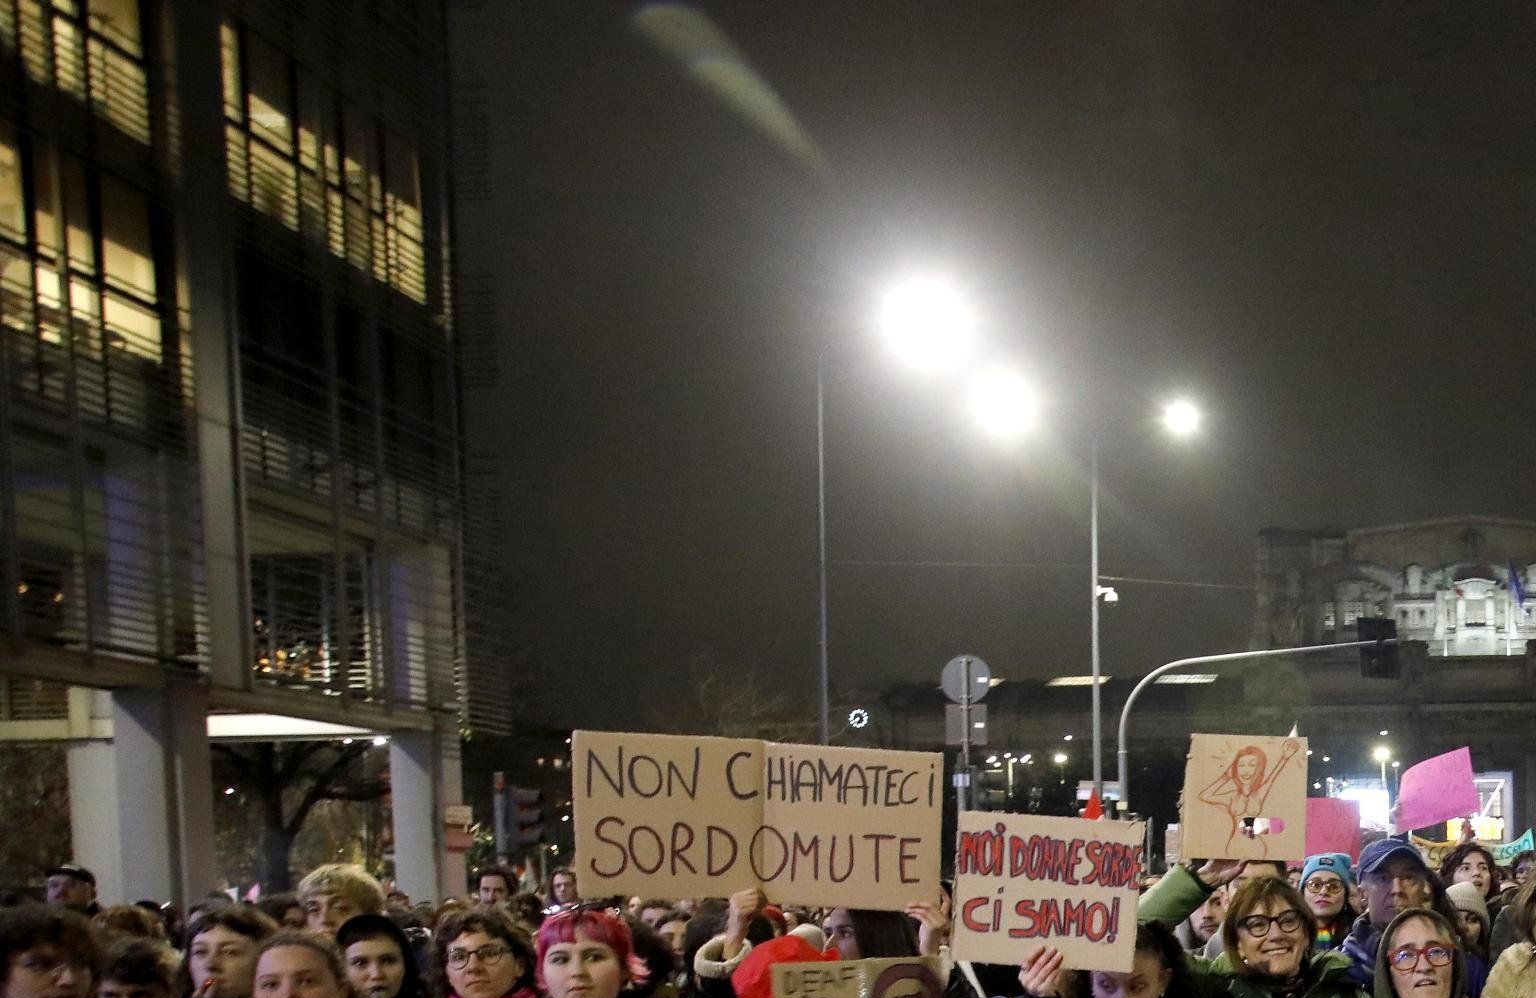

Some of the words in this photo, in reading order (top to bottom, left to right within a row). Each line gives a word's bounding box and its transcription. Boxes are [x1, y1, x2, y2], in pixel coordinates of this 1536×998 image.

[587, 746, 699, 800] NON
[590, 816, 921, 883] SORDOMUTE
[1009, 835, 1085, 885] DONNE
[1082, 841, 1144, 890] SORDE
